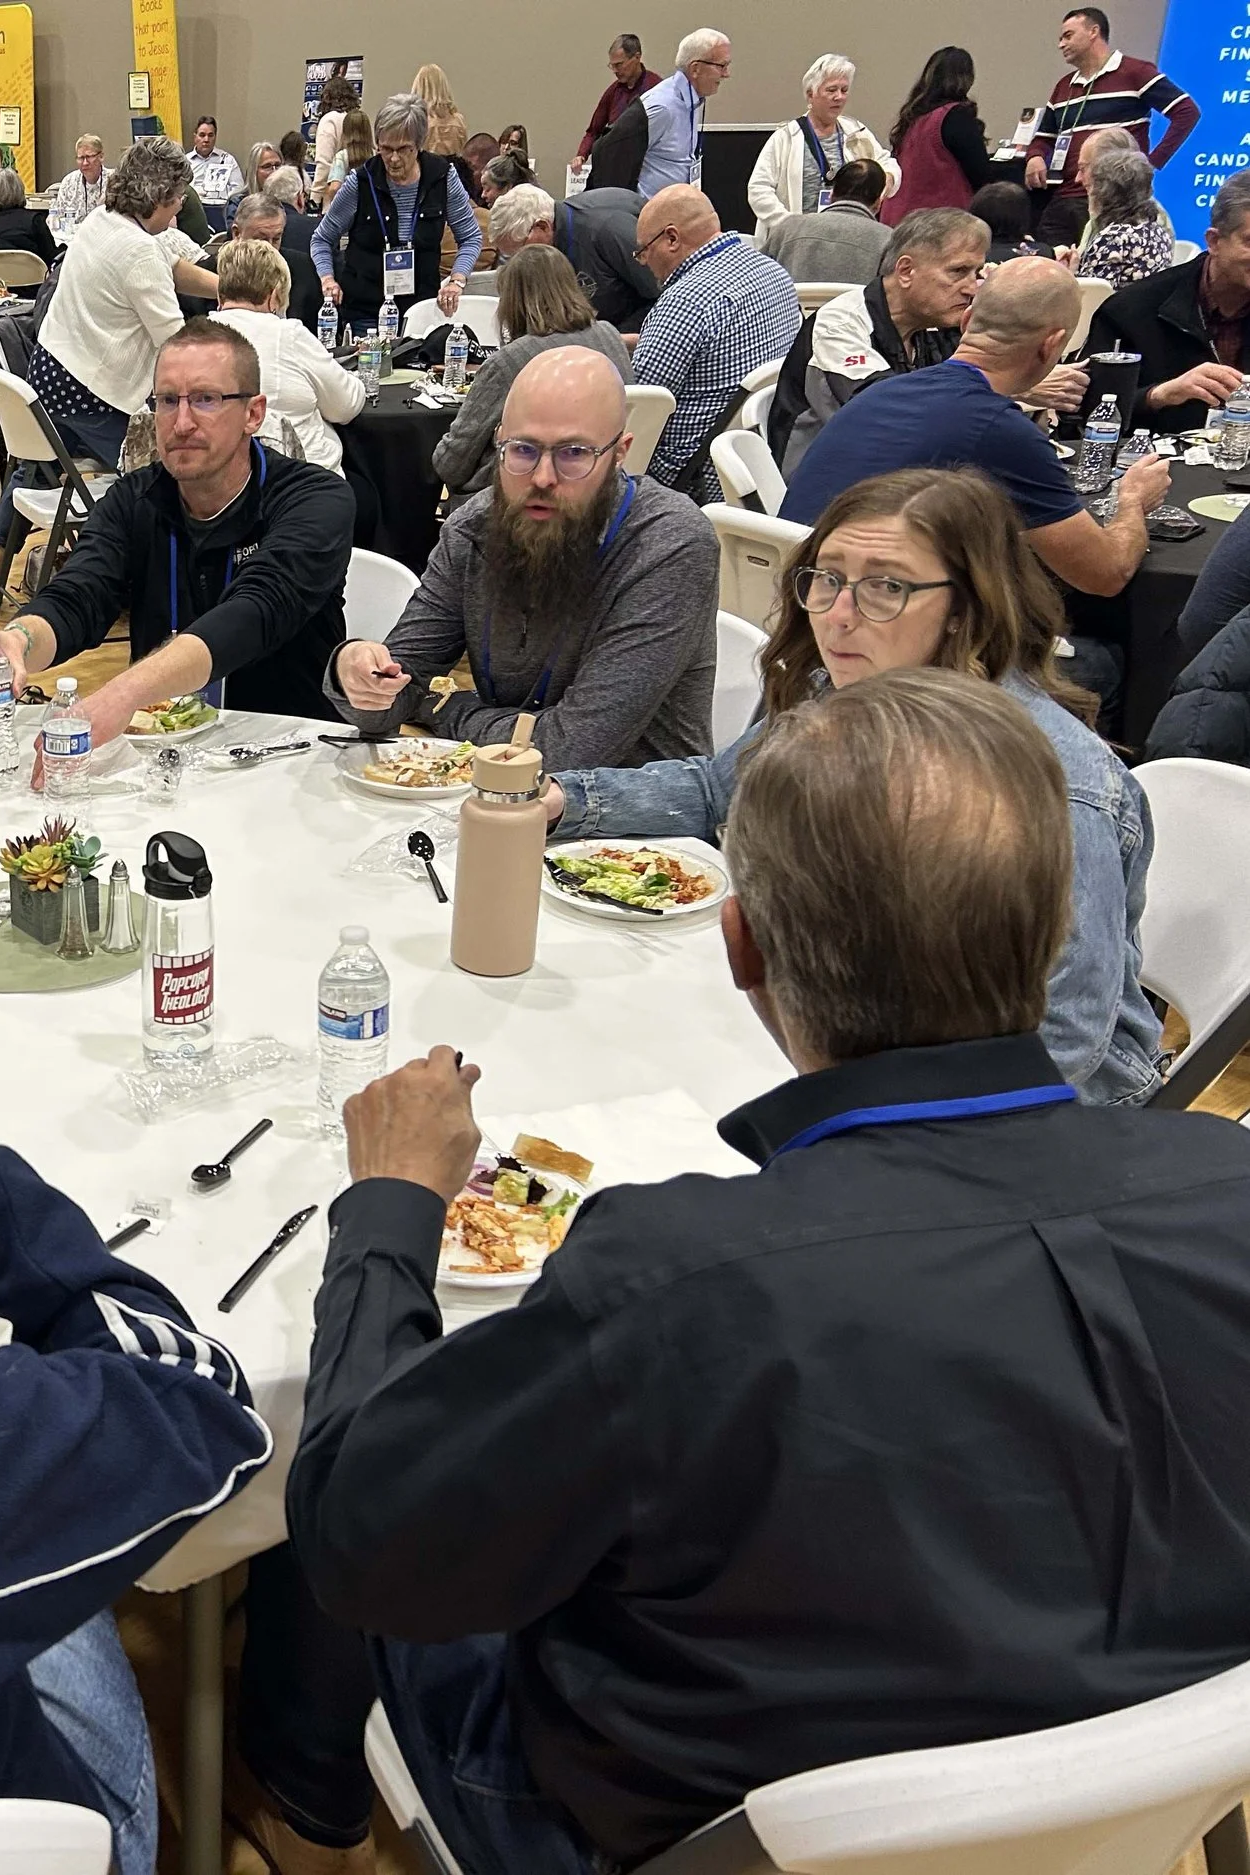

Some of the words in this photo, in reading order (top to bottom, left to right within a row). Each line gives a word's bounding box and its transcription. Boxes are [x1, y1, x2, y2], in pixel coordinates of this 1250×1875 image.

[138, 43, 147, 57] to
[147, 40, 170, 56] Jesus
[1222, 90, 1250, 104] ME
[1194, 153, 1250, 167] CAND
[844, 355, 866, 367] SI
